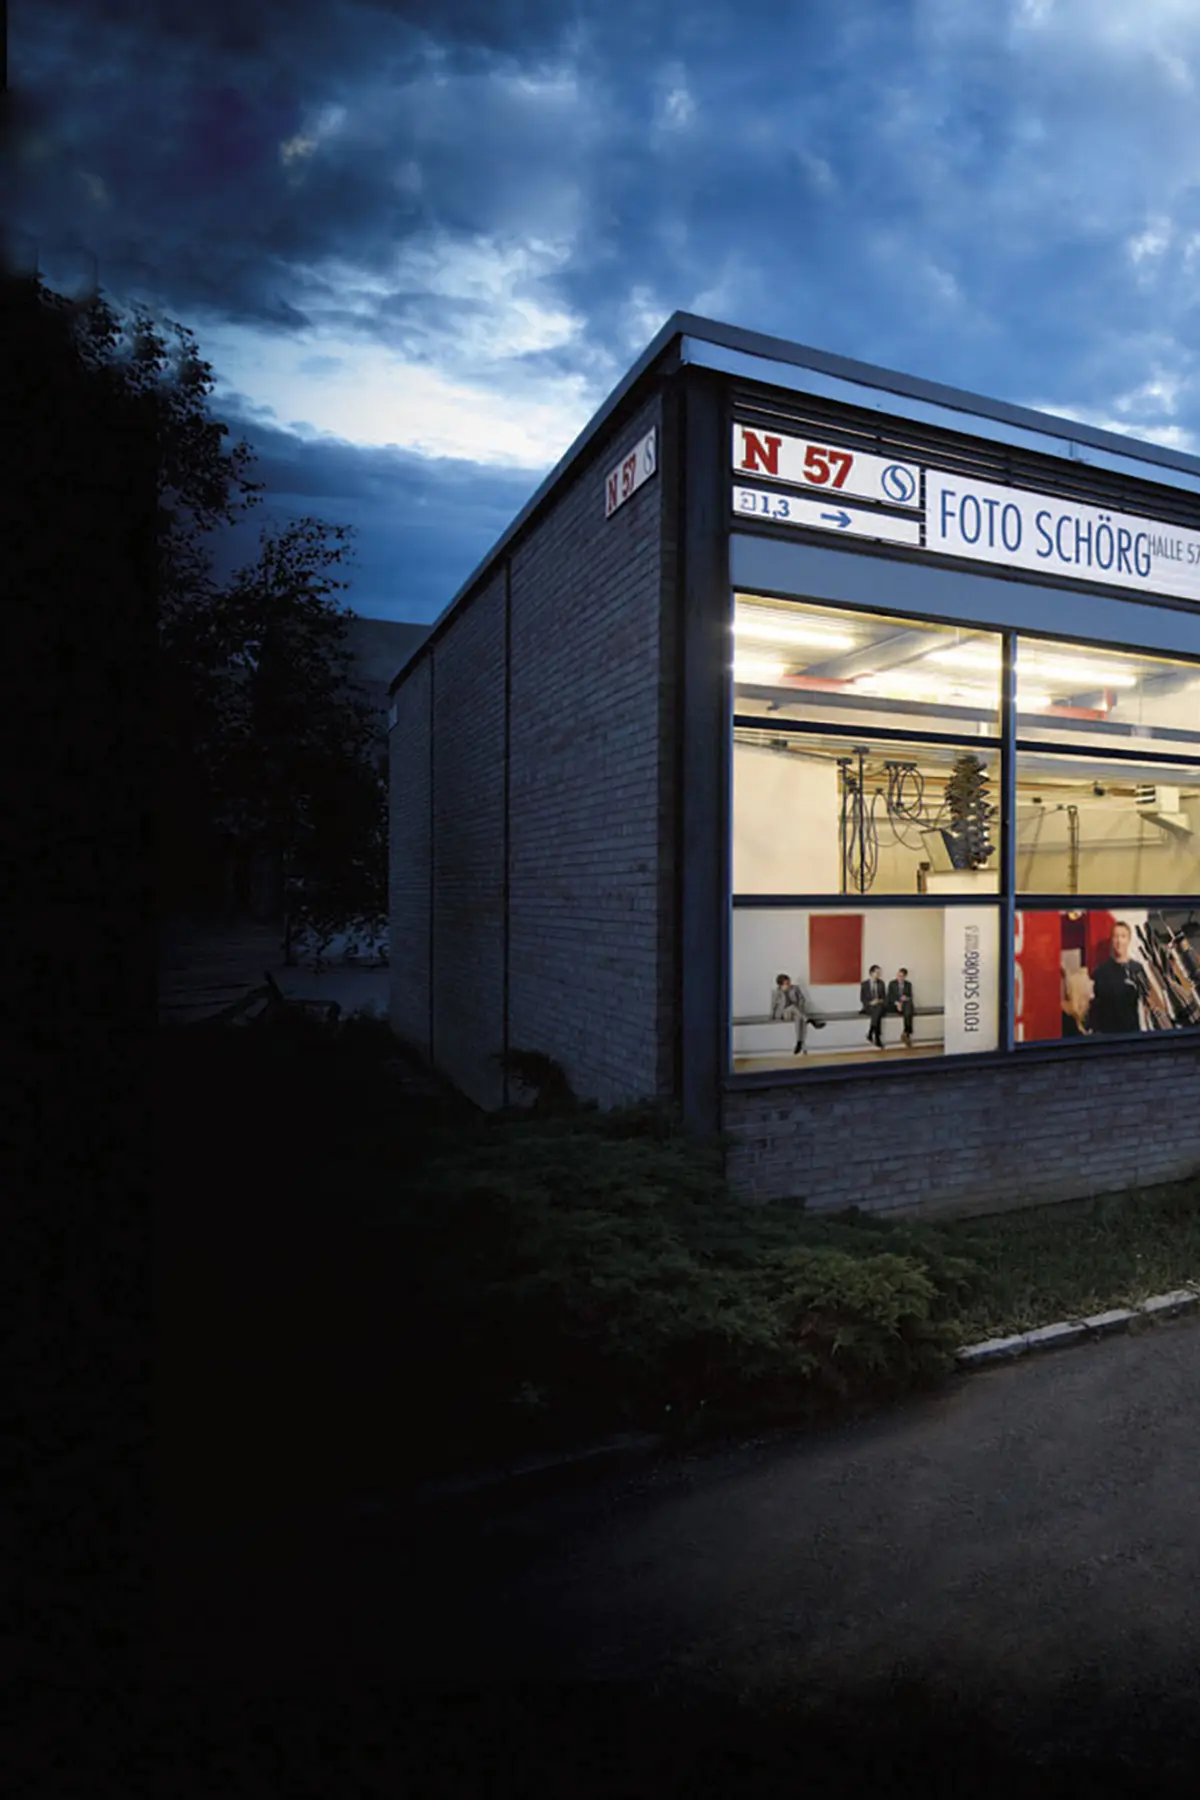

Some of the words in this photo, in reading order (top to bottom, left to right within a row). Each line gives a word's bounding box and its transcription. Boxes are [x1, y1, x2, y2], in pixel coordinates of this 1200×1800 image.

[741, 430, 782, 475] N
[803, 445, 854, 489] 57
[607, 471, 618, 512] N
[761, 496, 790, 519] 1,3
[940, 489, 1023, 552] FOTO
[1035, 510, 1151, 577] SCHÖRG
[1148, 534, 1183, 562] HALLE
[961, 951, 980, 999] SCHÖRG
[964, 1002, 980, 1033] FOTO
